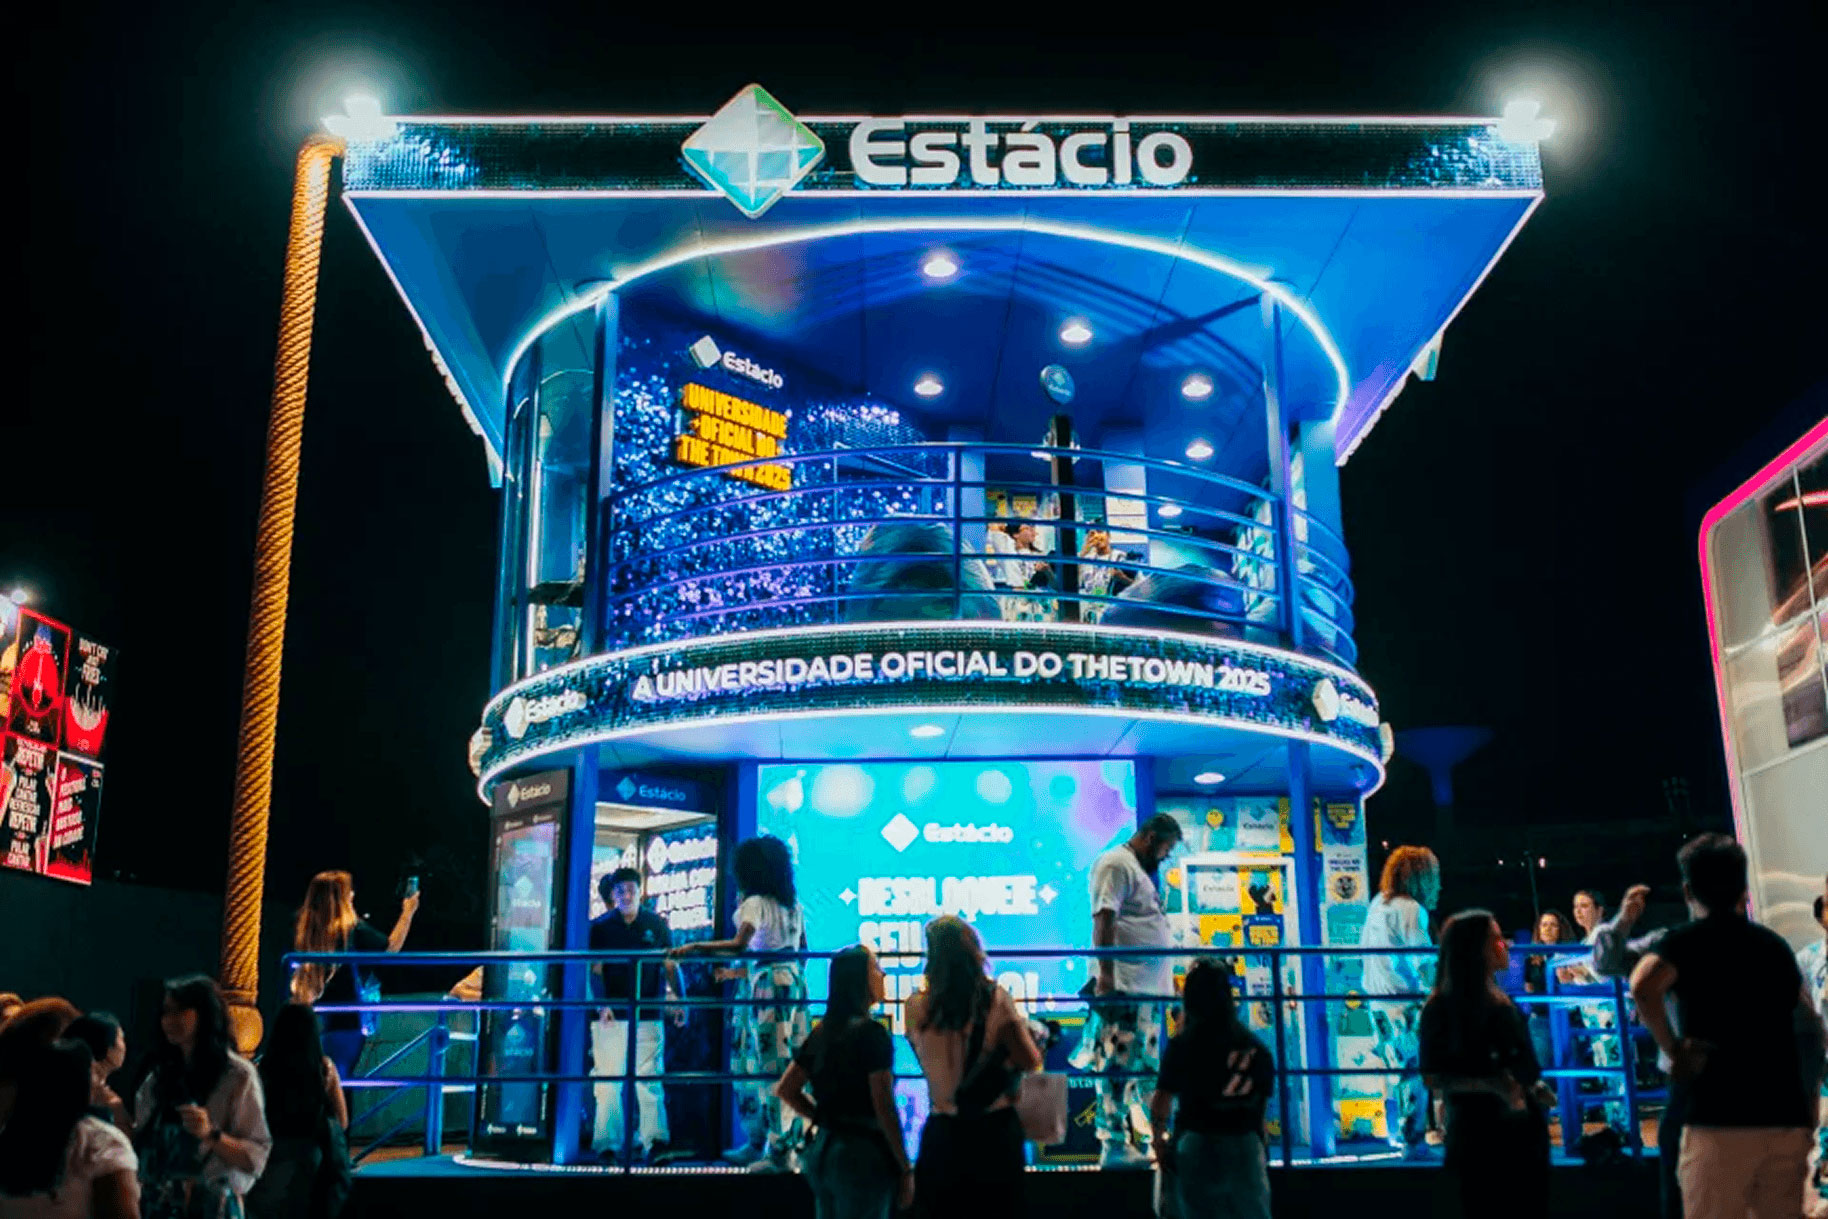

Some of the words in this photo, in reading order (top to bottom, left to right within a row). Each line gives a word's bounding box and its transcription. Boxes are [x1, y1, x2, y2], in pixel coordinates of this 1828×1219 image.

[849, 118, 1193, 186] Estácio
[722, 351, 784, 389] Estácio
[684, 382, 788, 440] UNIVERSIDADE
[700, 413, 755, 456] OFICIAL
[632, 675, 652, 701] A
[655, 653, 873, 697] UNIVERSIDADE
[880, 650, 1007, 678] OFICIAL
[1014, 651, 1063, 678] DO
[1069, 653, 1216, 688] THETOWN
[1218, 666, 1272, 697] 2025
[638, 784, 687, 801] Estácio
